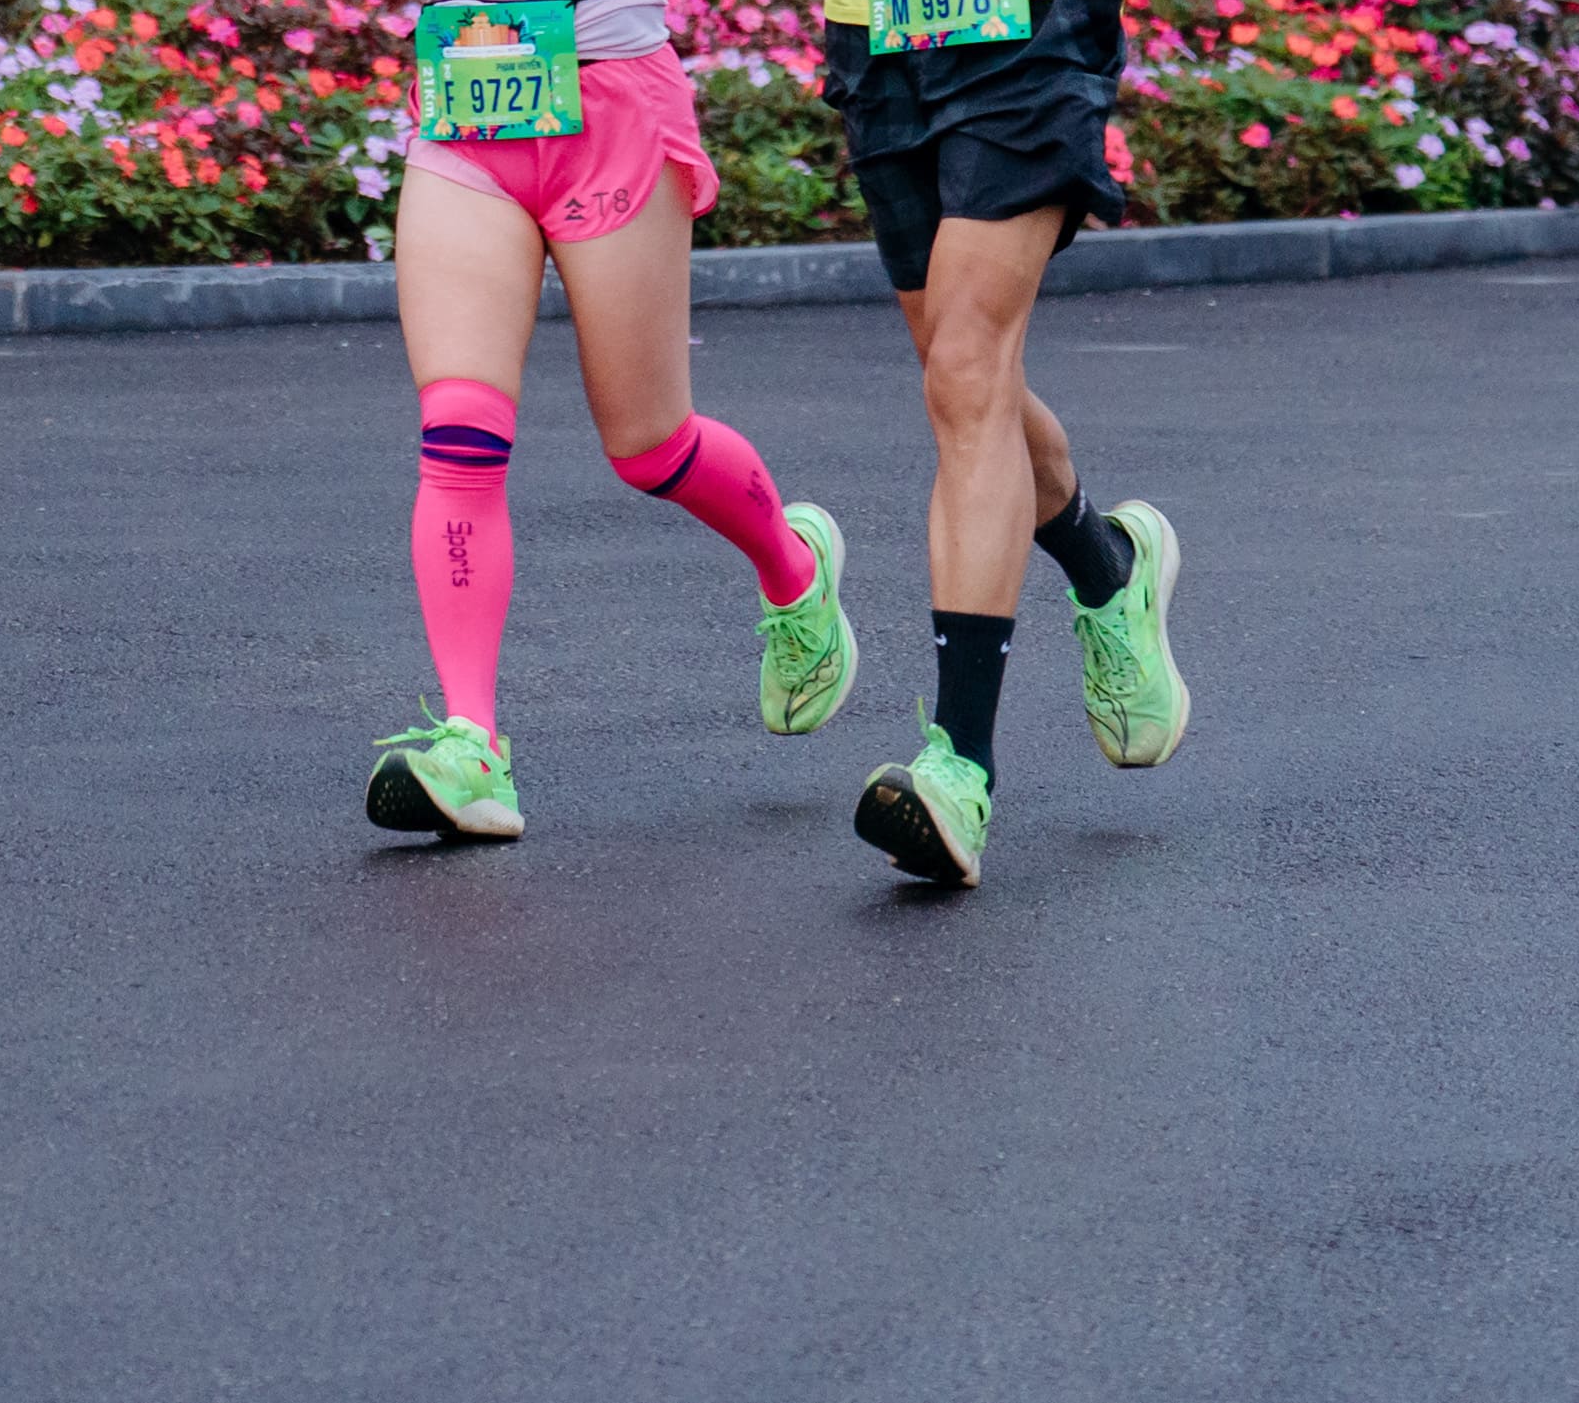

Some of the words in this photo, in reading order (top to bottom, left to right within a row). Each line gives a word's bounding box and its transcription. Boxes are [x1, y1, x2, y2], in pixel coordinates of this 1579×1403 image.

[445, 81, 454, 115] F
[470, 76, 542, 113] 9727
[591, 188, 630, 219] T8
[441, 520, 475, 587] Sports
